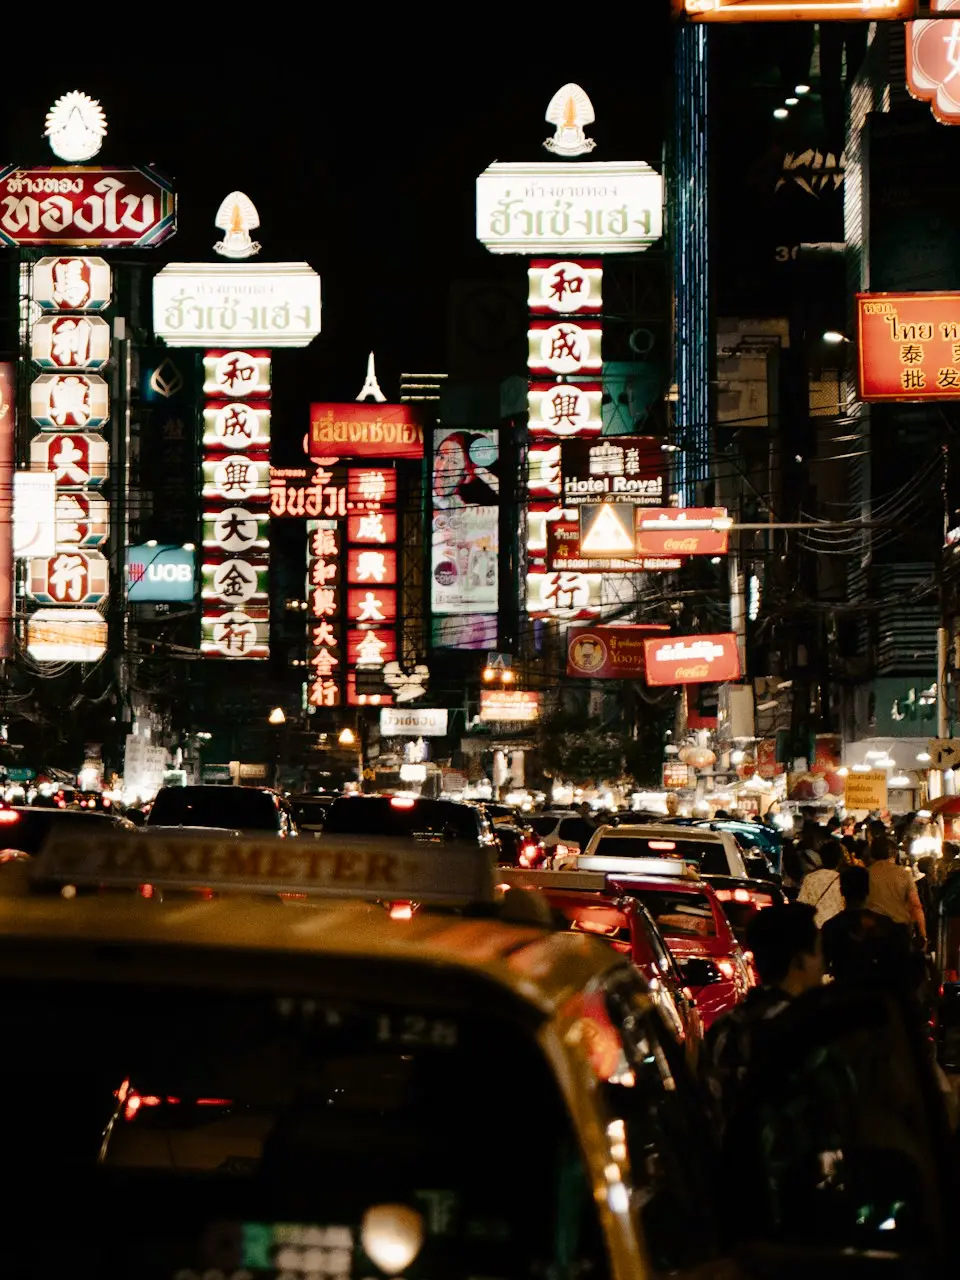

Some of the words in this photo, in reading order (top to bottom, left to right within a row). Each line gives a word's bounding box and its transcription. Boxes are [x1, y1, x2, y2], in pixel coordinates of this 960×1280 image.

[564, 476, 609, 493] Hotel
[613, 476, 662, 494] Royal
[219, 359, 255, 652] 和成興大金行
[148, 563, 192, 582] UOB
